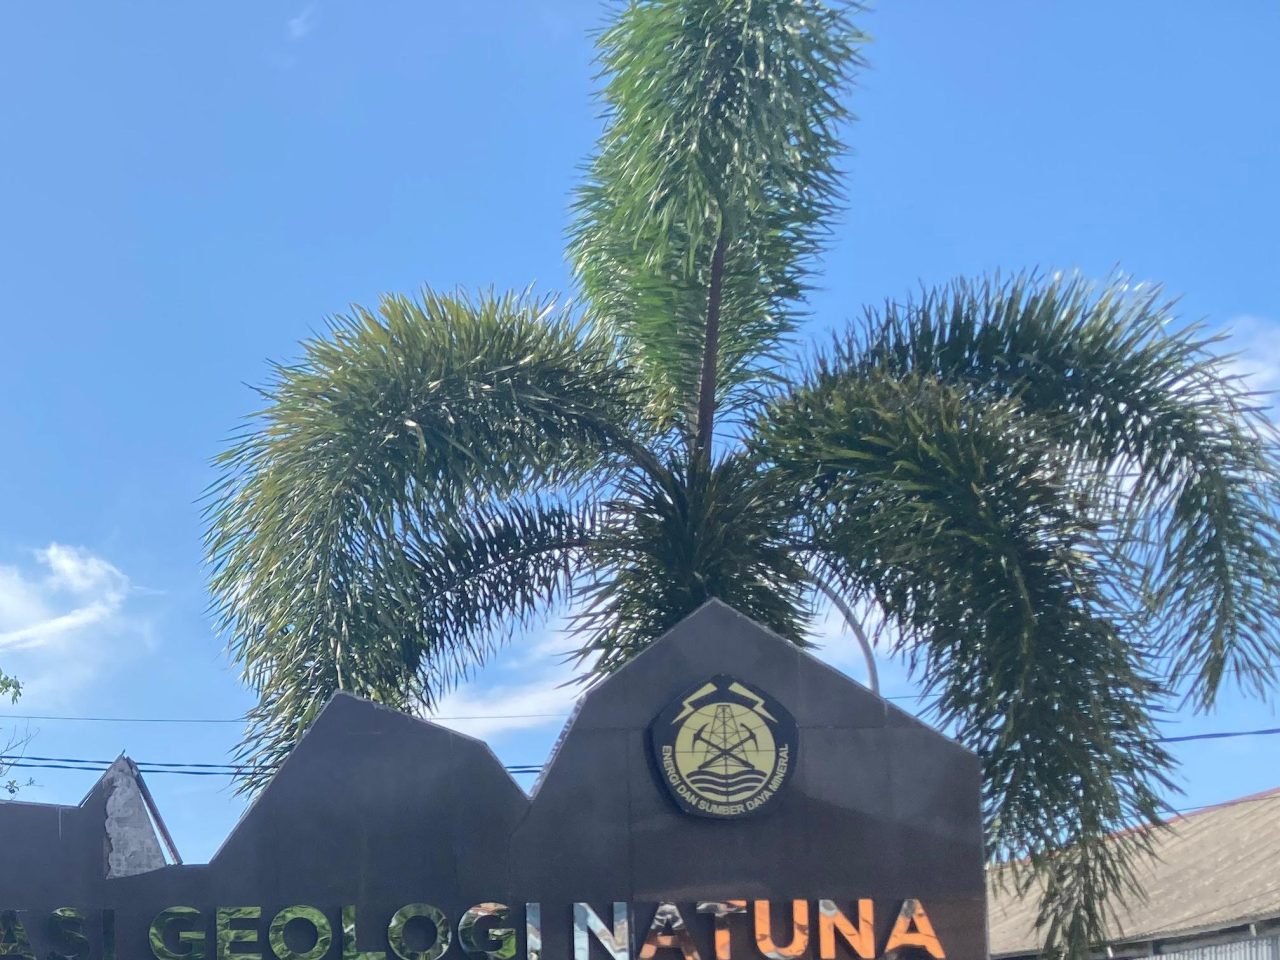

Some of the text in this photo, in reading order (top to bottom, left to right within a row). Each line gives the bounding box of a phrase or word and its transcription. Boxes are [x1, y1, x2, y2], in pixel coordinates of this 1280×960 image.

[662, 743, 789, 815] ENERGI DAN SUMBER DAYA MINERAL
